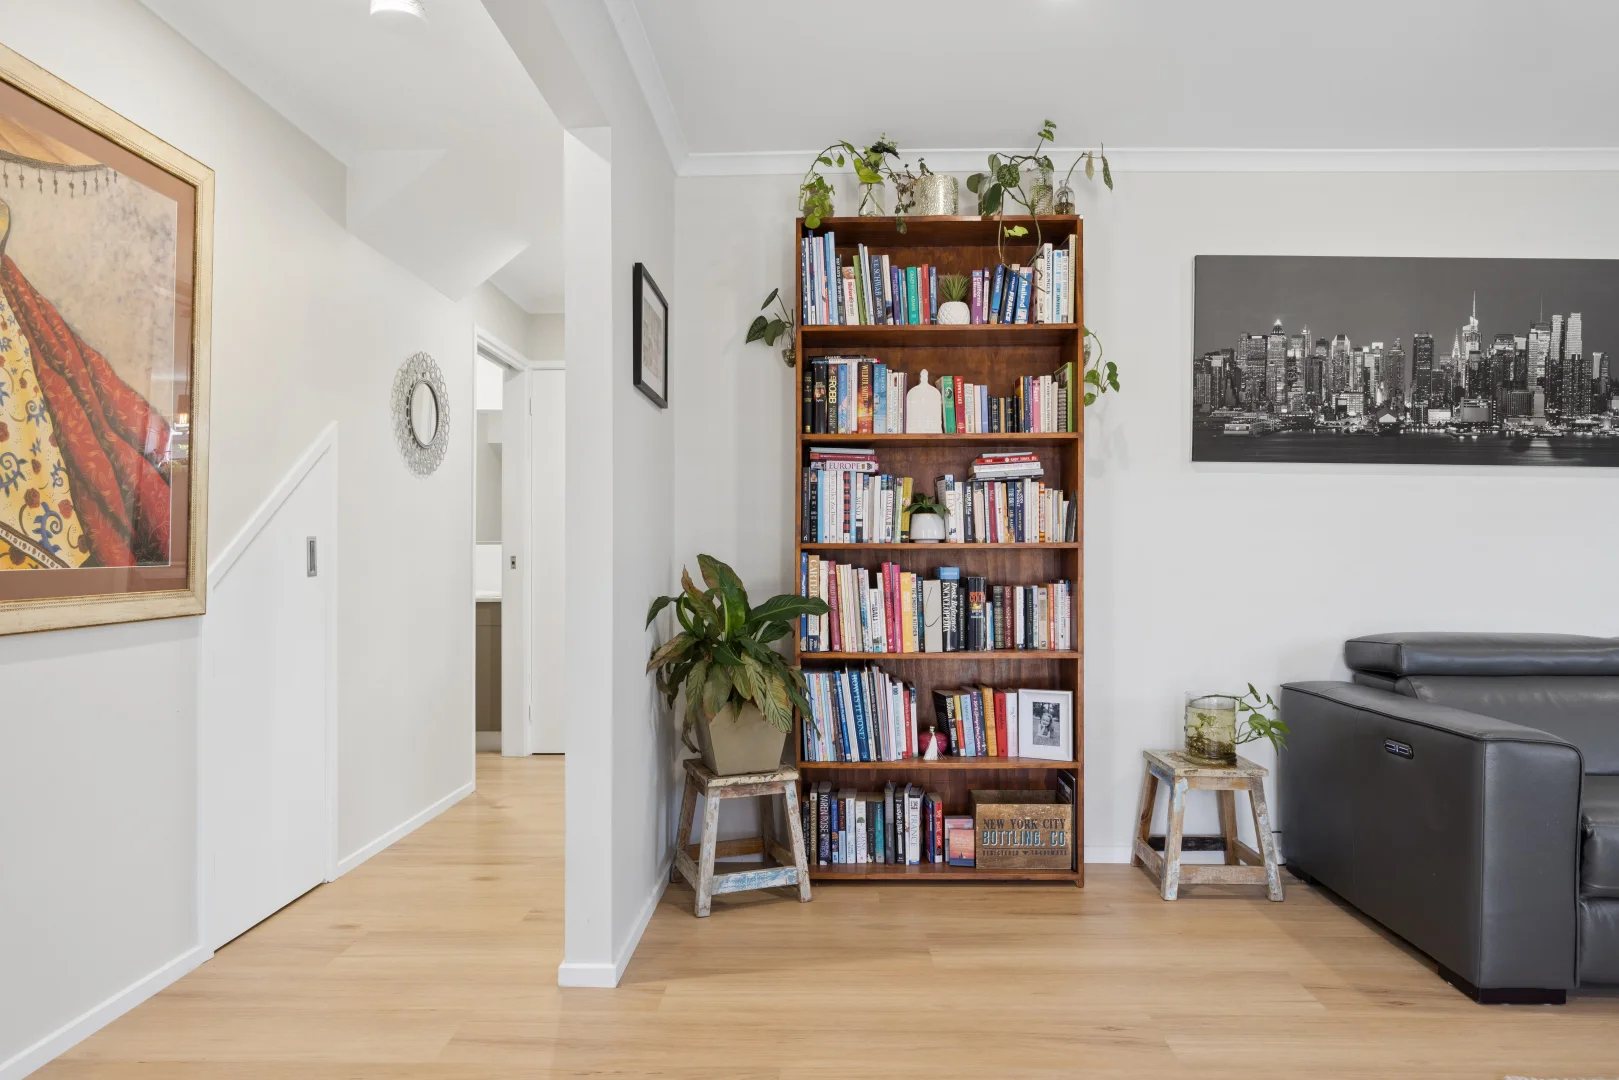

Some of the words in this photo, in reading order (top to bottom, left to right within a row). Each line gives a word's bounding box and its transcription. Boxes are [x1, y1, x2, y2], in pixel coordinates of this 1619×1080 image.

[855, 704, 861, 713] IT
[856, 715, 865, 740] DONE?
[820, 794, 828, 814] KAREN
[820, 816, 828, 832] ROSE
[983, 820, 1004, 829] NEW
[1010, 819, 1037, 829] YORK
[1043, 819, 1066, 829] CITY
